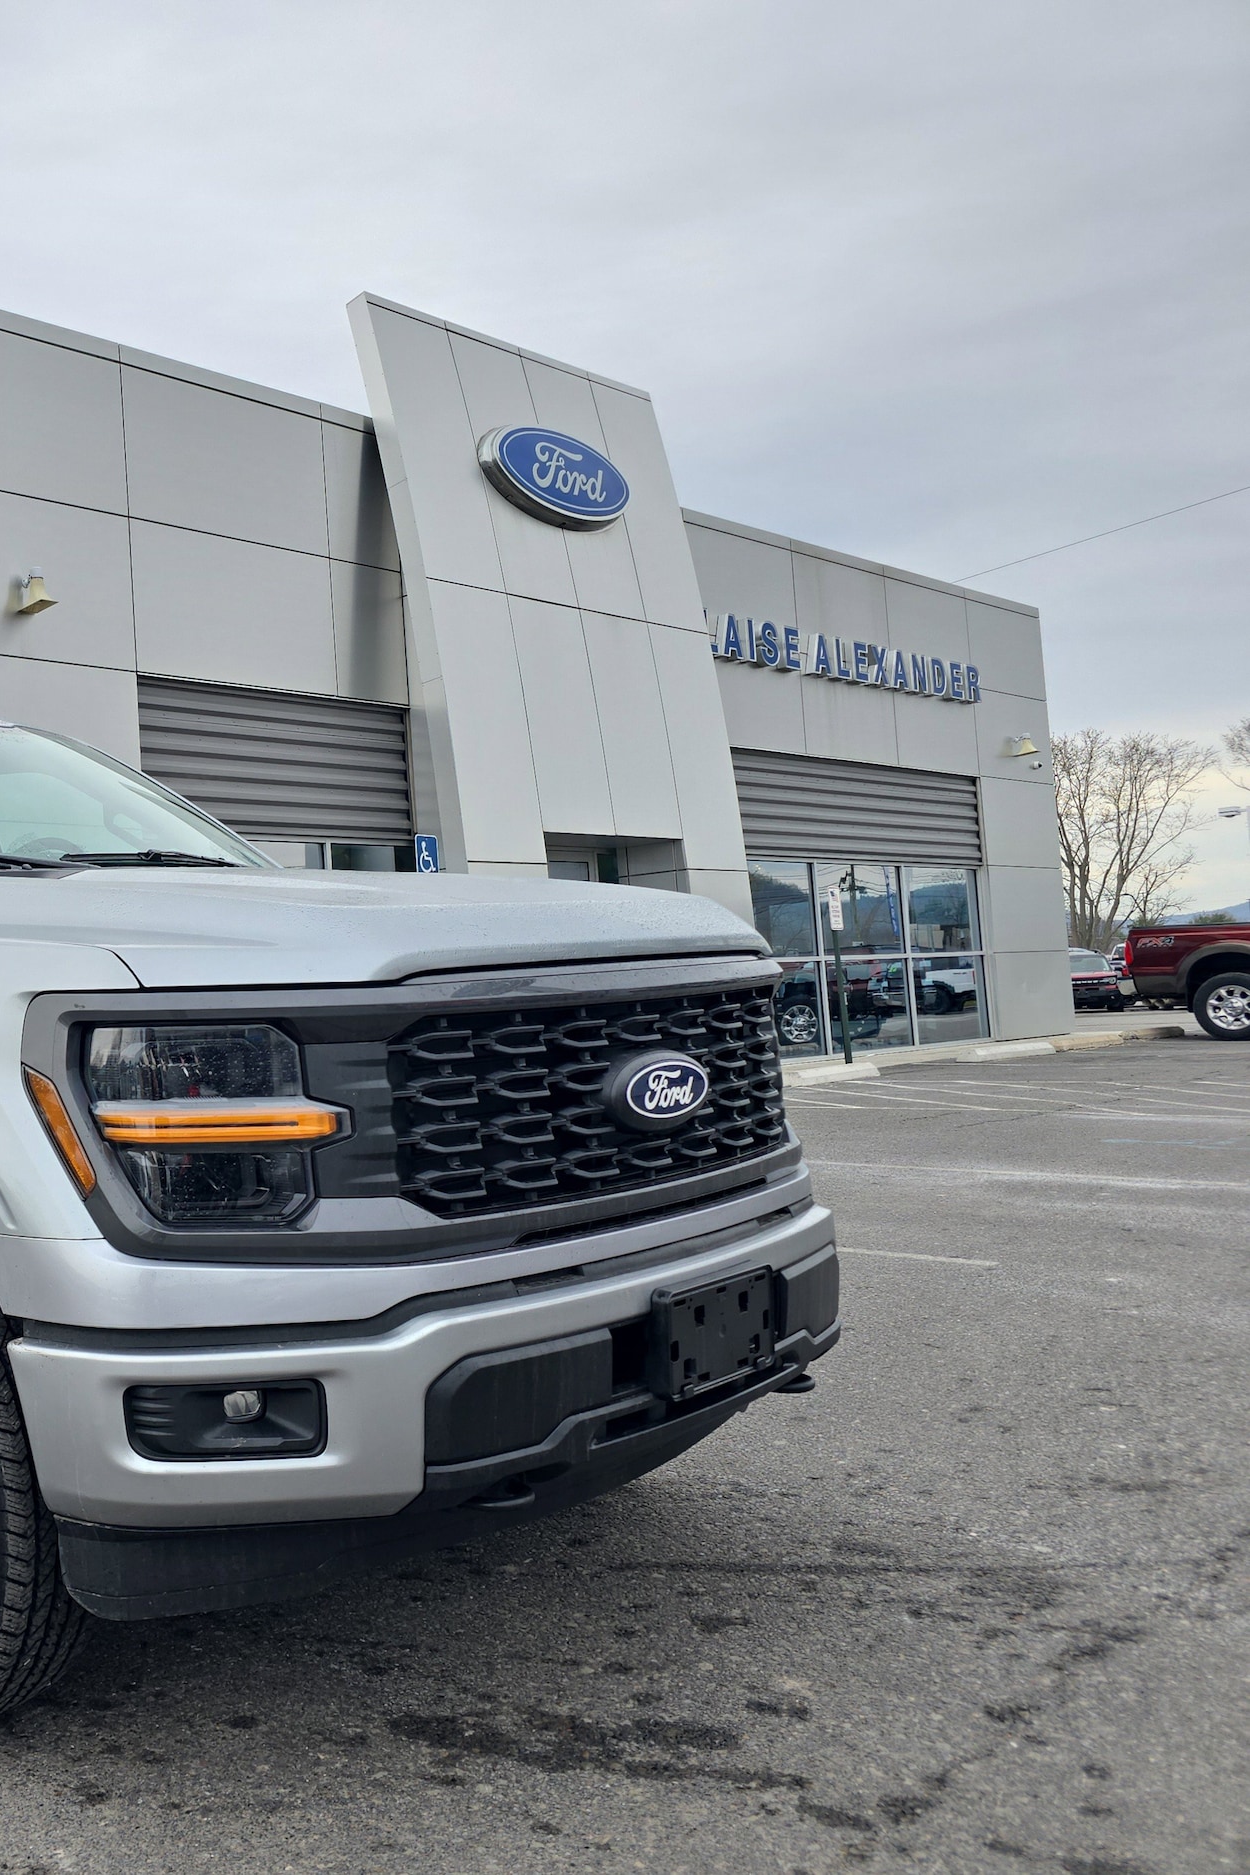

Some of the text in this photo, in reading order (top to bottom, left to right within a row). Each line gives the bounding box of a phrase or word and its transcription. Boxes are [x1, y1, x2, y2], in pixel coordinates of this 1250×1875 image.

[532, 441, 607, 503] Ford
[810, 632, 982, 703] ALEXANDER
[644, 1069, 694, 1110] Ford
